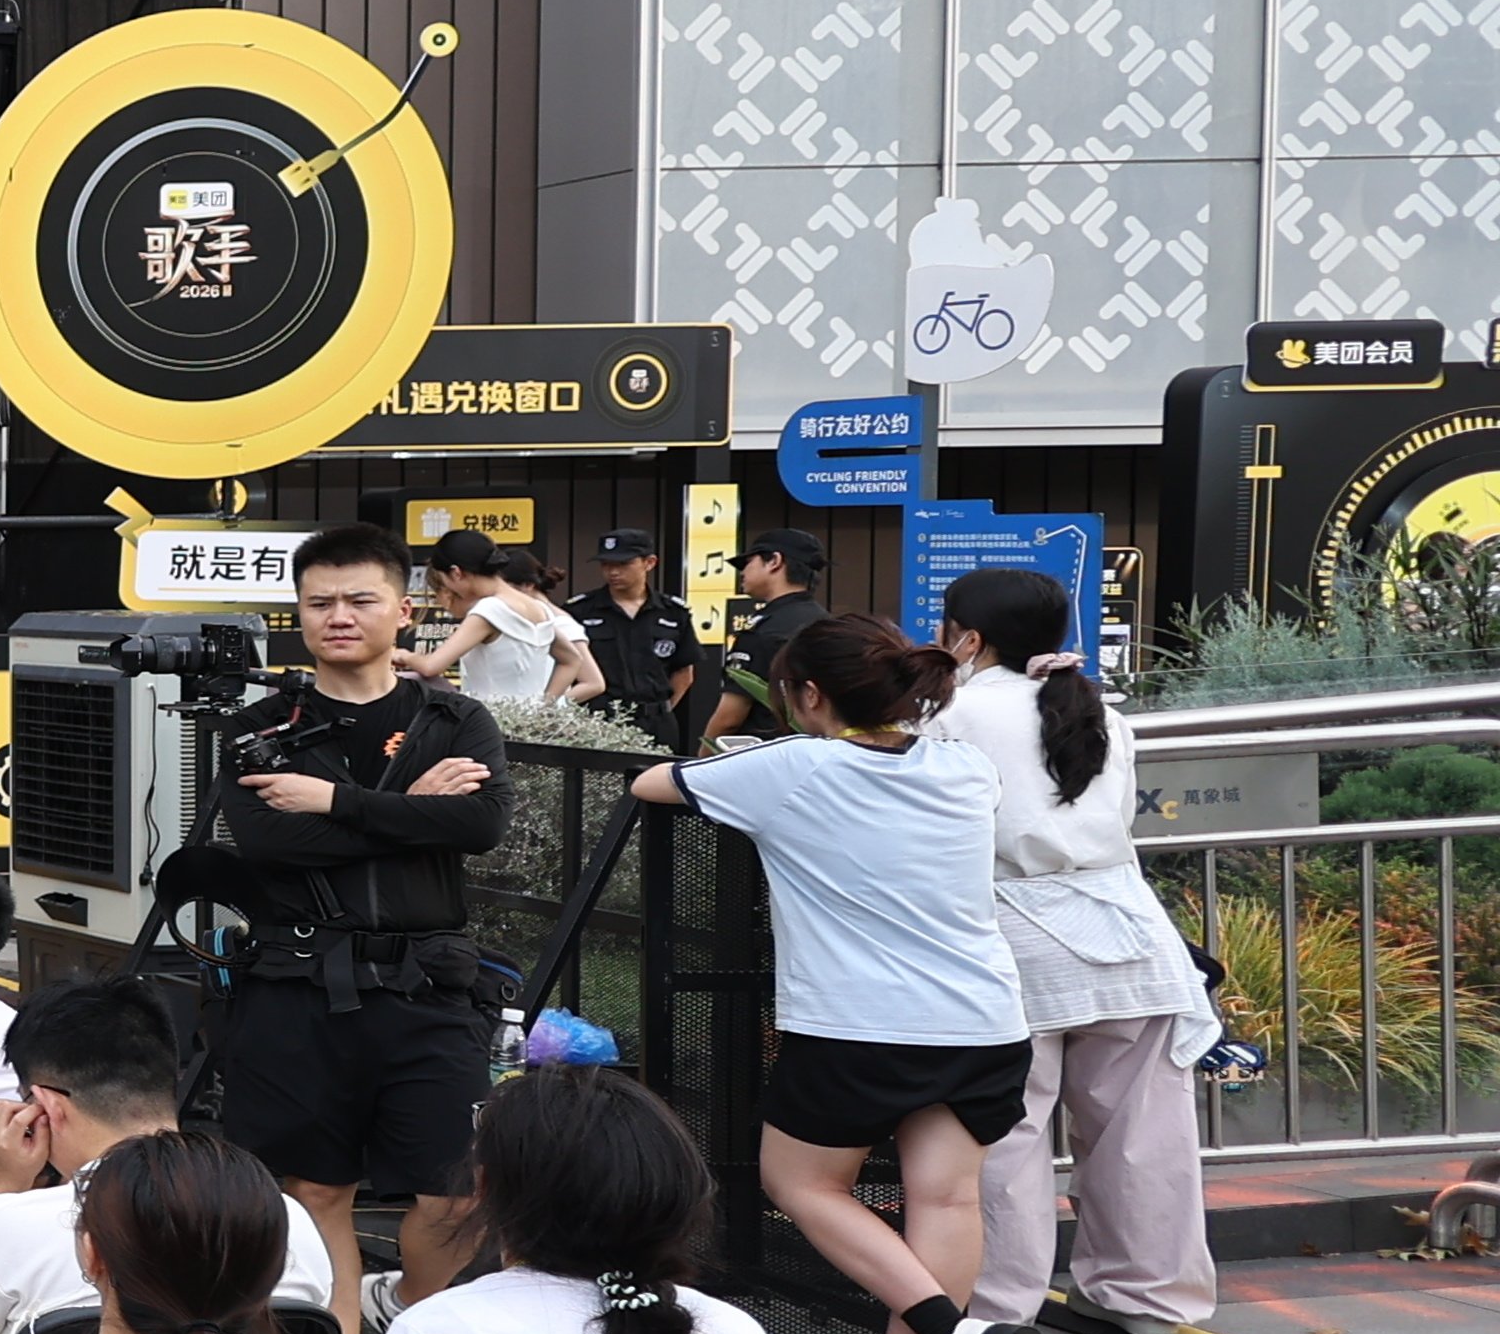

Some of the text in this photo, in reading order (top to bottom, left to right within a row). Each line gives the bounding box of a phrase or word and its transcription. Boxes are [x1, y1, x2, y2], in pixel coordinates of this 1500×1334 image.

[192, 191, 227, 207] 美团
[136, 218, 258, 291] 歌手
[180, 284, 220, 298] 2026
[1314, 340, 1413, 365] 美团会员
[368, 380, 582, 416] 礼遇兑换窗口
[799, 412, 910, 438] 骑行友好公约
[806, 469, 908, 483] CYCLING FRIENDLY
[835, 482, 908, 494] CONVENTION
[462, 514, 519, 532] 兑换处
[169, 545, 286, 583] 就是有
[1183, 787, 1241, 806] 萬象城
